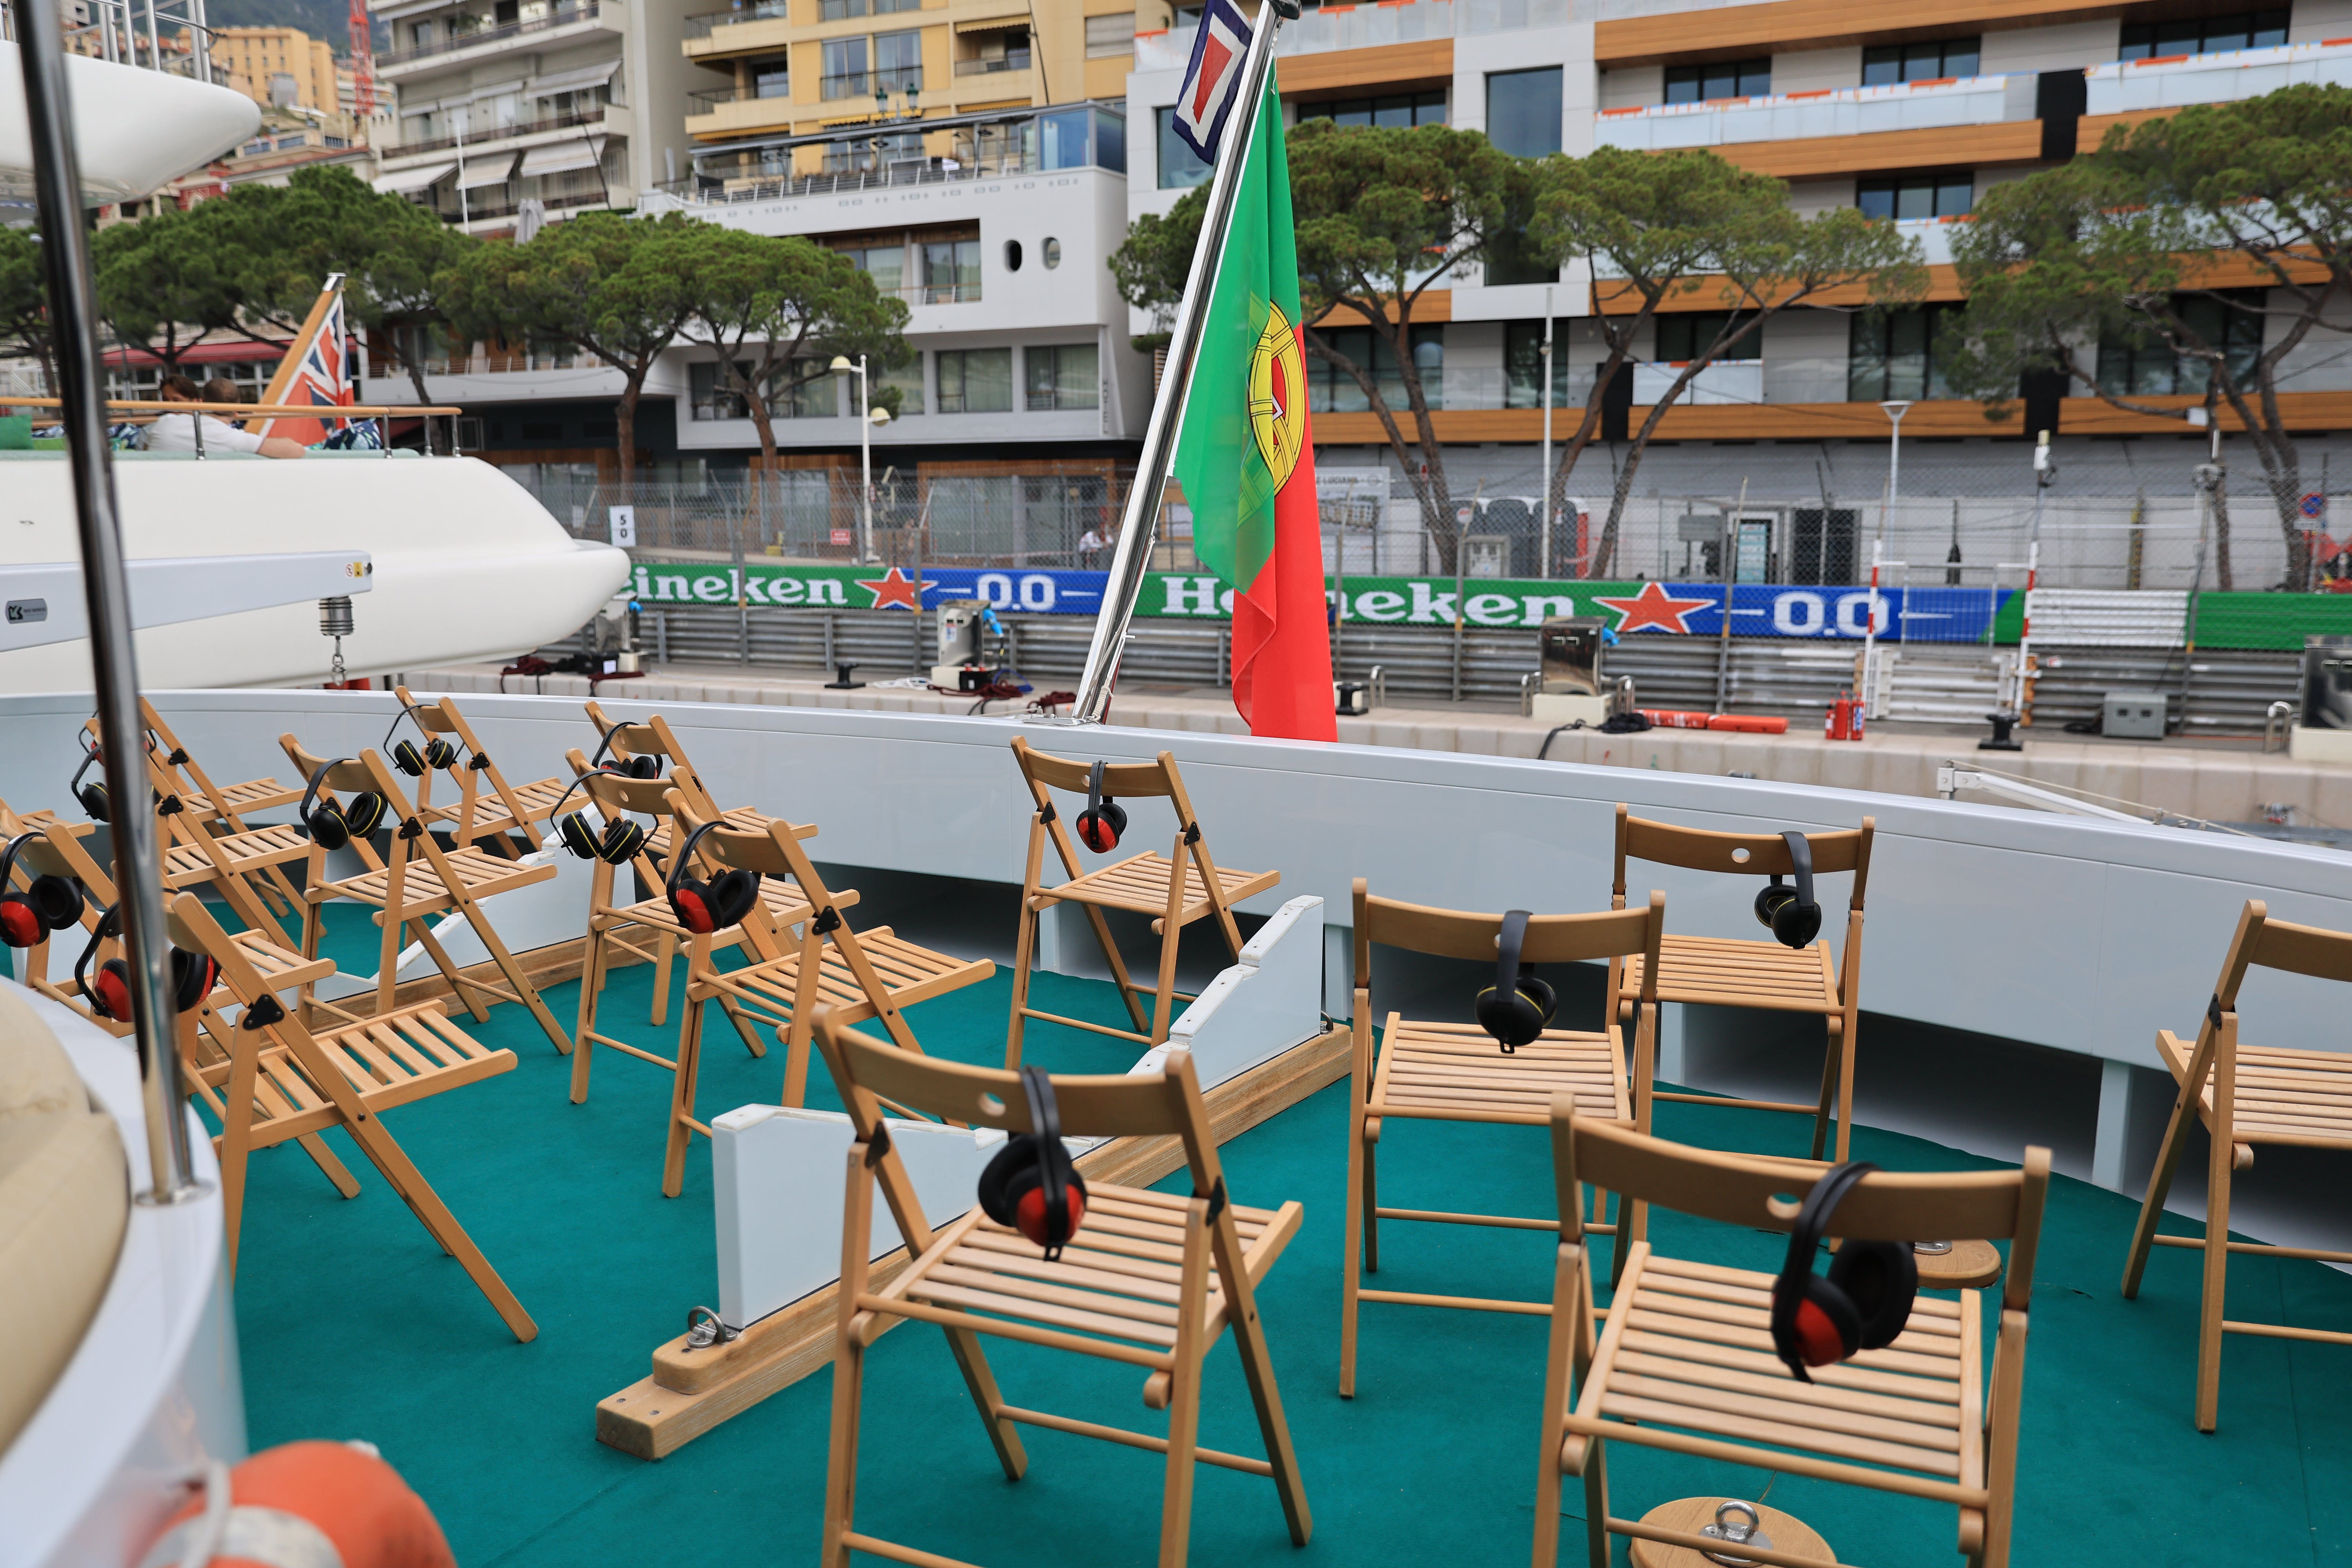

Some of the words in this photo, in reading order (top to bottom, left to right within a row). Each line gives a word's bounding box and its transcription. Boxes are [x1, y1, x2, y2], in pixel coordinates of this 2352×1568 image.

[620, 566, 848, 604] ineken
[978, 573, 1055, 611] 0.0
[1773, 591, 1890, 636] 0.0
